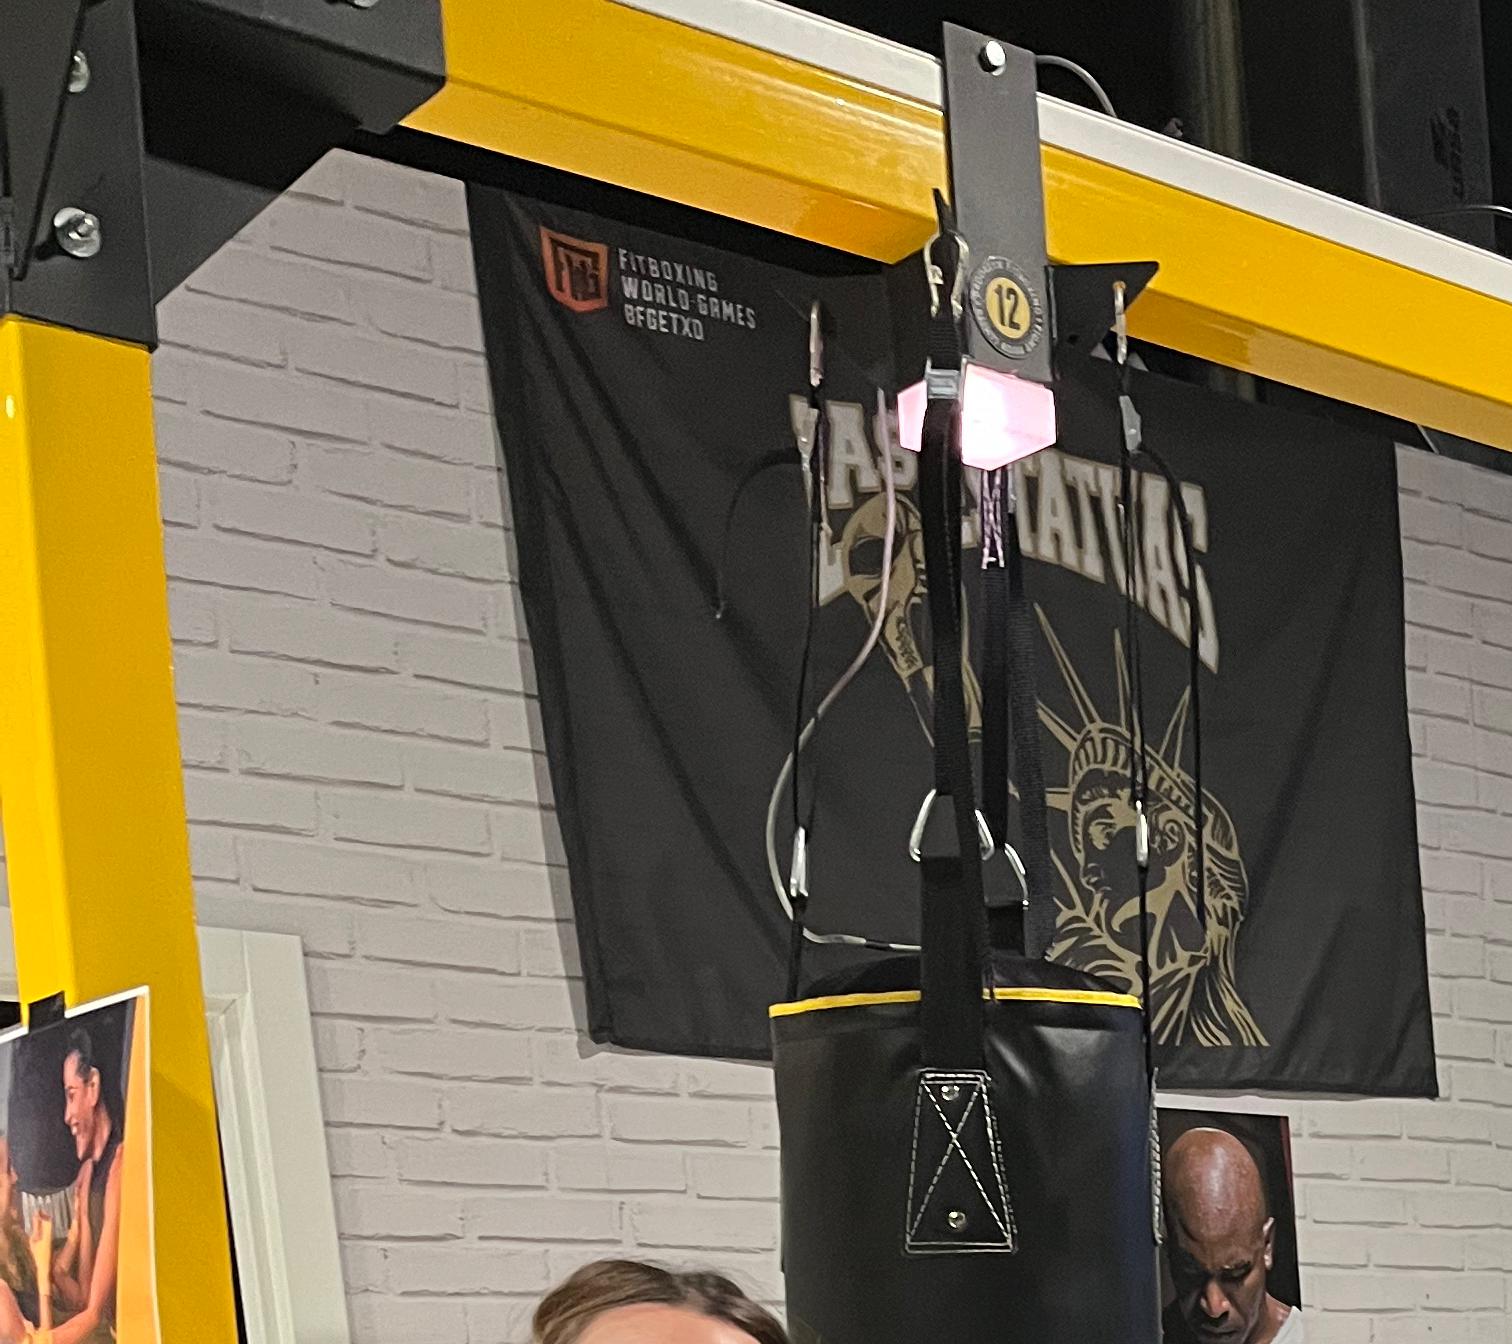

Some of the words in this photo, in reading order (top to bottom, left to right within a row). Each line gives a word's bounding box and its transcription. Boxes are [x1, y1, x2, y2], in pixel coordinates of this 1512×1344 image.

[618, 248, 718, 292] FITBOXING
[621, 275, 690, 311] WORLD
[696, 293, 757, 329] GAMES
[994, 283, 1021, 331] 12
